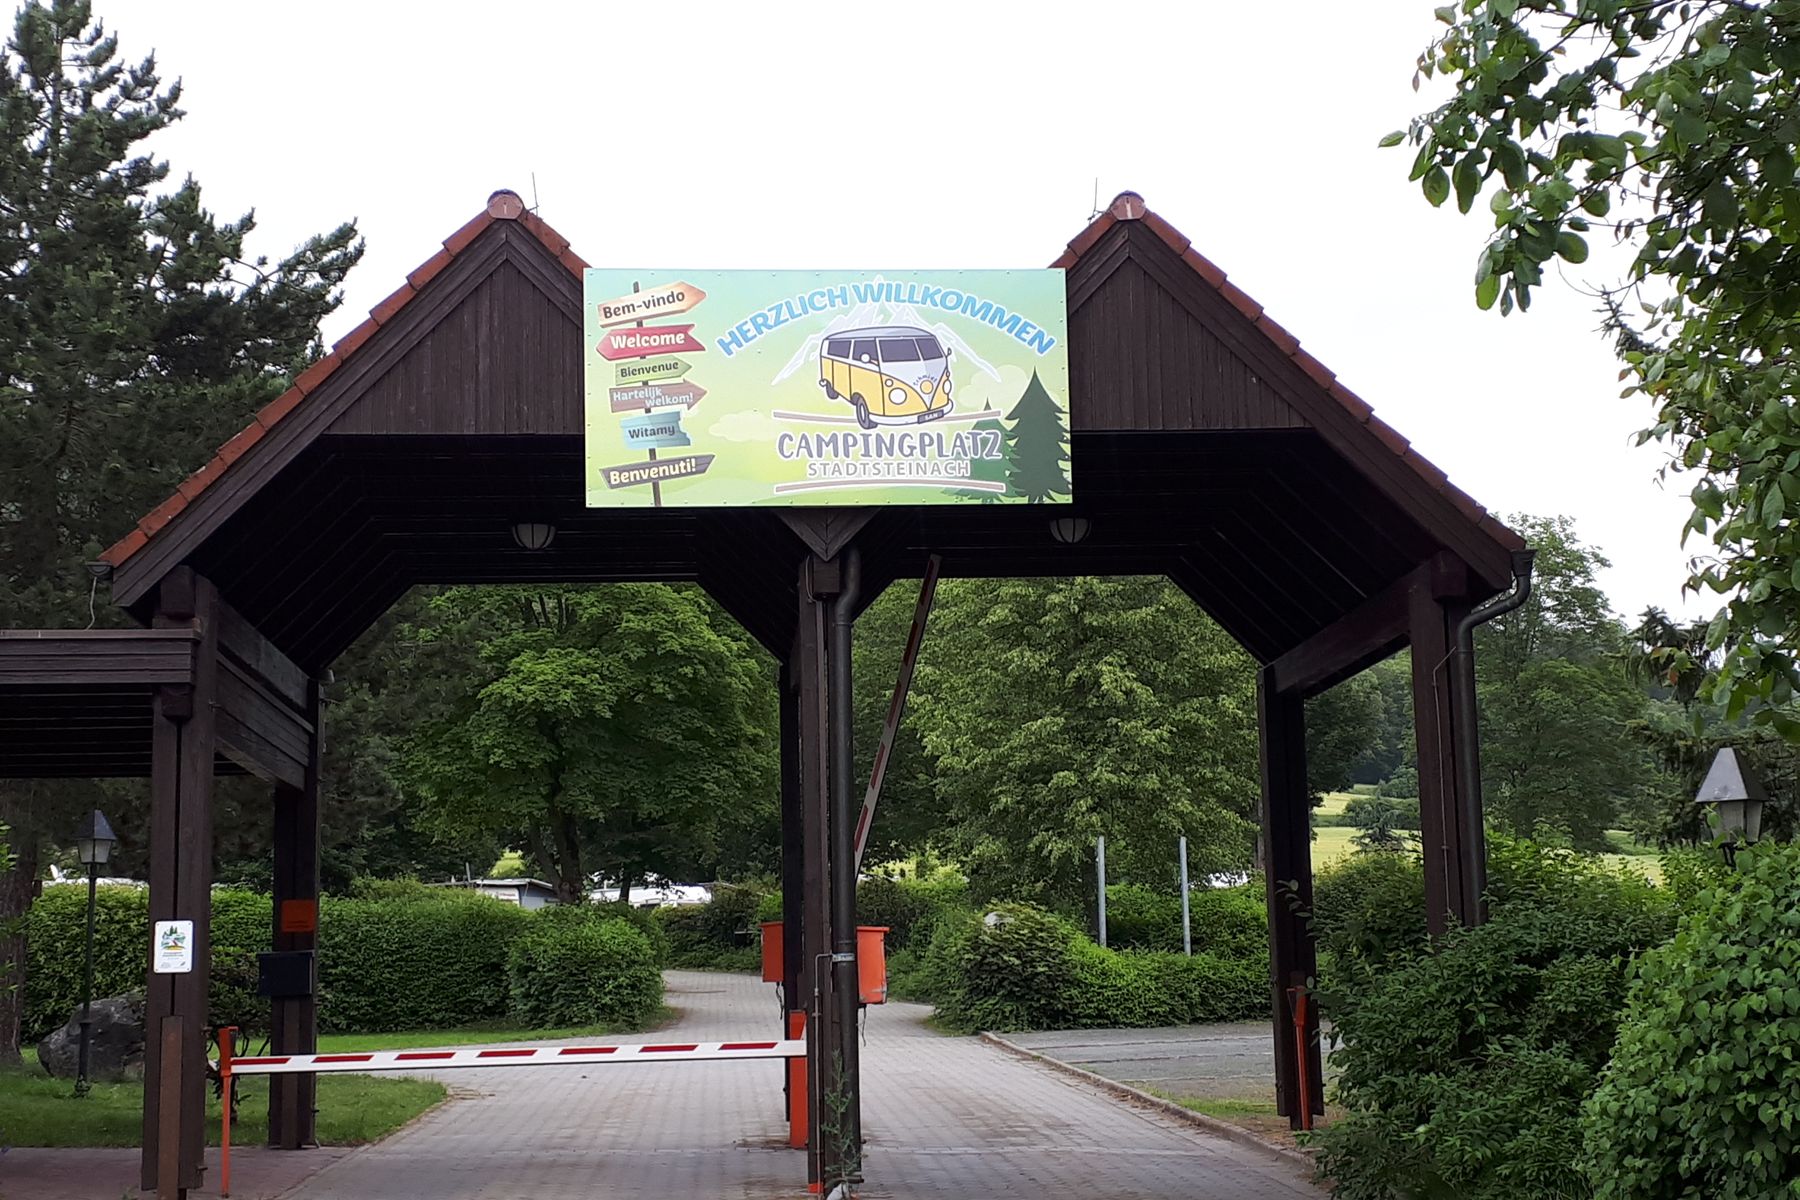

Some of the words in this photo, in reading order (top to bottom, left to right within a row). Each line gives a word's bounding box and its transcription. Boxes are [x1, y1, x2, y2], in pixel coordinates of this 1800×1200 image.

[602, 290, 686, 319] Bem-vindo
[717, 286, 848, 356] HERZLICH
[852, 282, 1055, 355] WILLKOMMEN
[610, 332, 685, 350] Welcome
[620, 360, 679, 378] Bienvenue
[613, 386, 662, 402] Hartelijk
[628, 425, 676, 439] Witamy
[778, 431, 1001, 459] CAMPINGPLATZ
[609, 457, 696, 485] Benvenuti!
[808, 462, 969, 477] STADTSTEINACH
